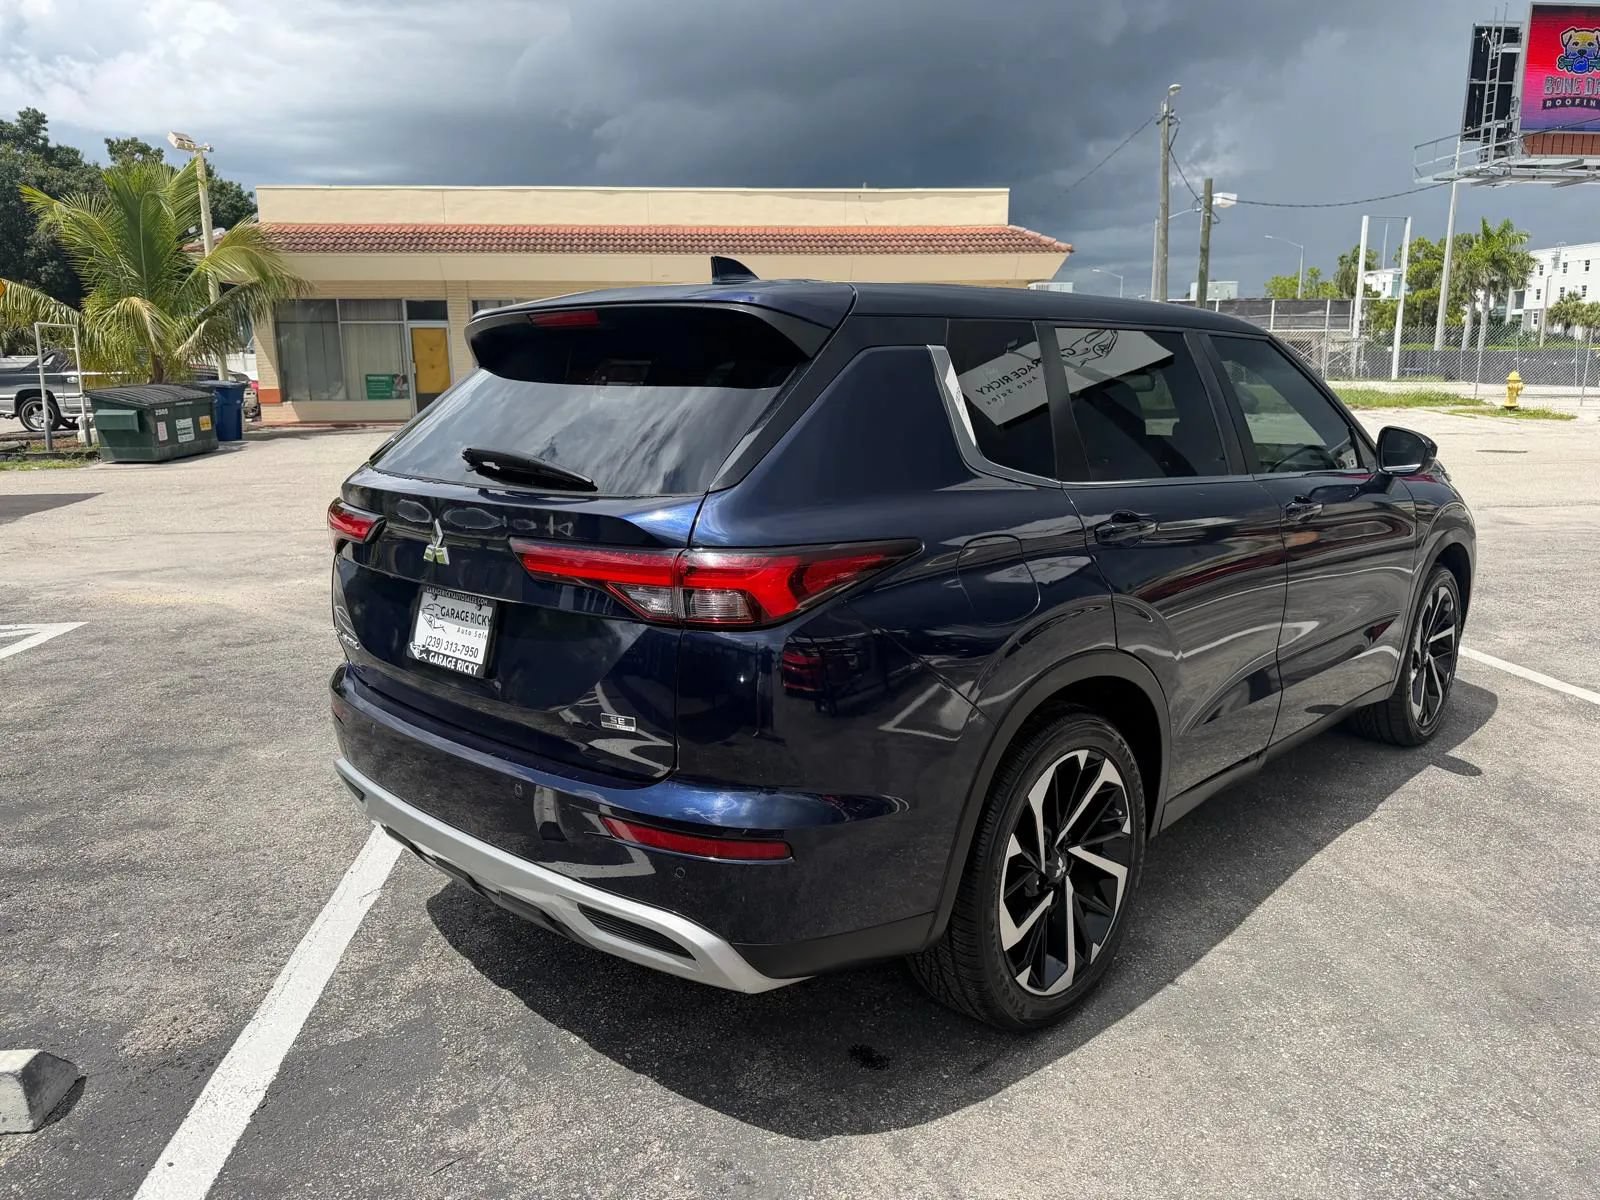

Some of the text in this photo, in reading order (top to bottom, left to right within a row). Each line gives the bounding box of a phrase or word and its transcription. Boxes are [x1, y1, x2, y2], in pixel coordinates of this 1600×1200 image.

[1545, 76, 1582, 95] BONE
[1546, 98, 1597, 107] ROOFIN
[440, 606, 492, 627] GARAGE RICKY
[457, 627, 471, 636] Auto
[425, 635, 478, 659] (239) 313-7950
[429, 652, 479, 676] GARAGE RICKY
[609, 717, 625, 726] SE
